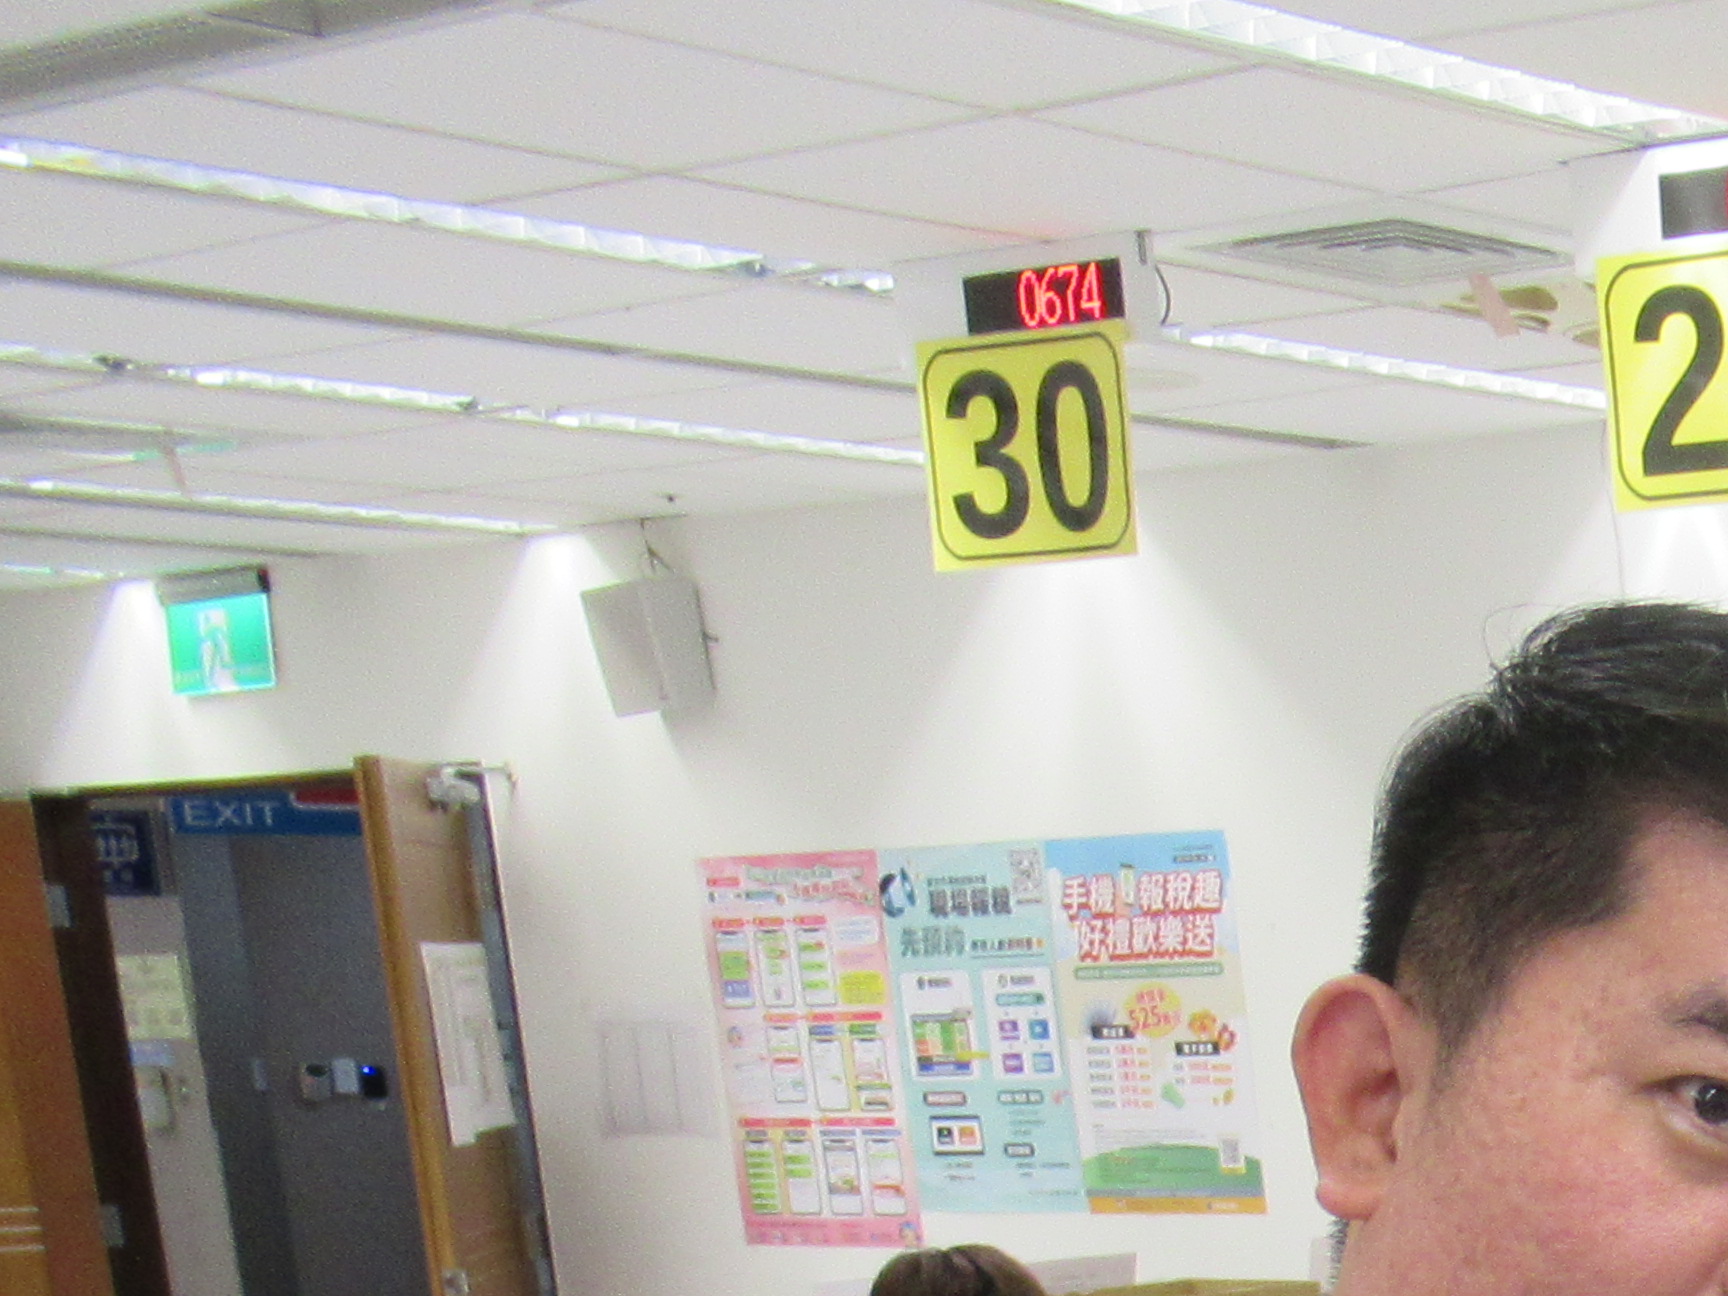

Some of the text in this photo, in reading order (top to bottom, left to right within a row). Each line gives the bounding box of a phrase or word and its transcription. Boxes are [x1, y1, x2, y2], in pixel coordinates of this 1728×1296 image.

[1018, 263, 1103, 328] 0674
[945, 360, 1109, 540] 30
[184, 798, 277, 827] EXIT
